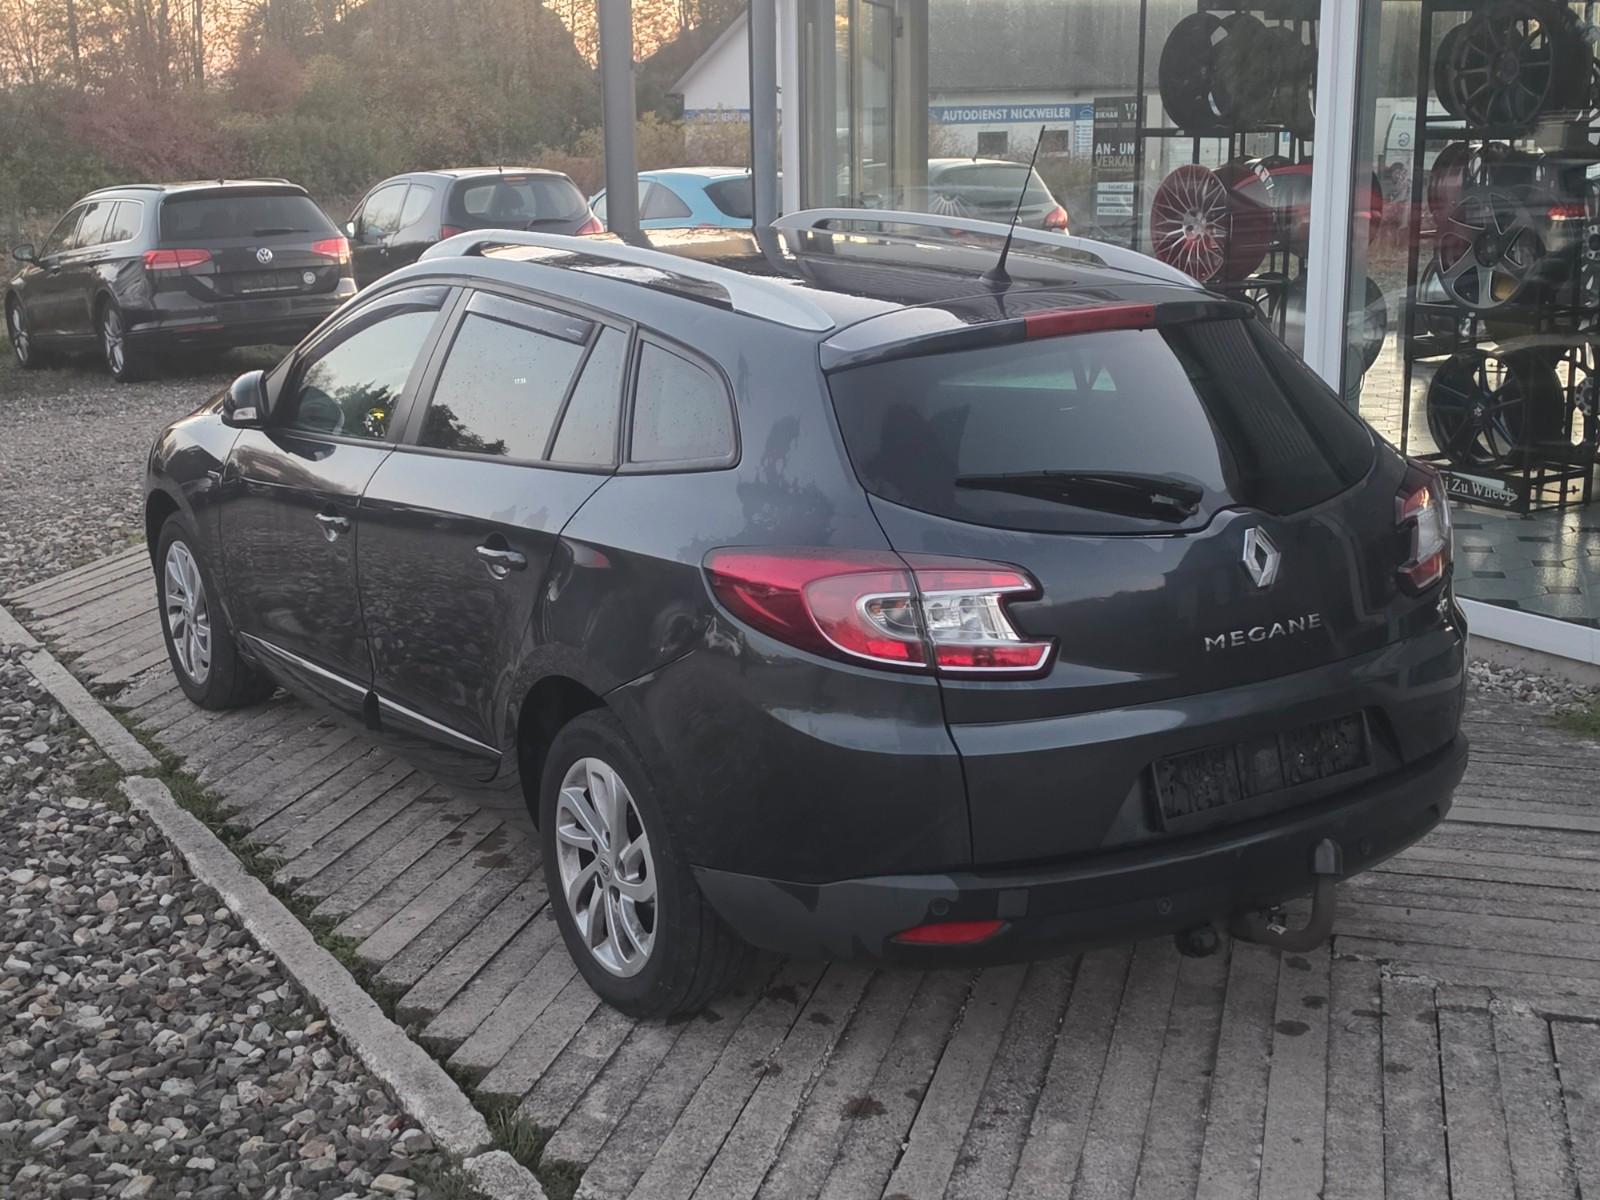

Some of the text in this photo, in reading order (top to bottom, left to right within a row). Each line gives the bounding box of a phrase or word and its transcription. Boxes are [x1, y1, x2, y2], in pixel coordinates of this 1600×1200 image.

[942, 107, 1071, 121] AUTODIENST NICKWEILER
[1095, 142, 1136, 155] AN- UN
[1096, 155, 1135, 168] VERKAU
[1451, 478, 1469, 494] Zu
[1471, 481, 1515, 502] Wheel
[1204, 613, 1321, 652] MEGANE
